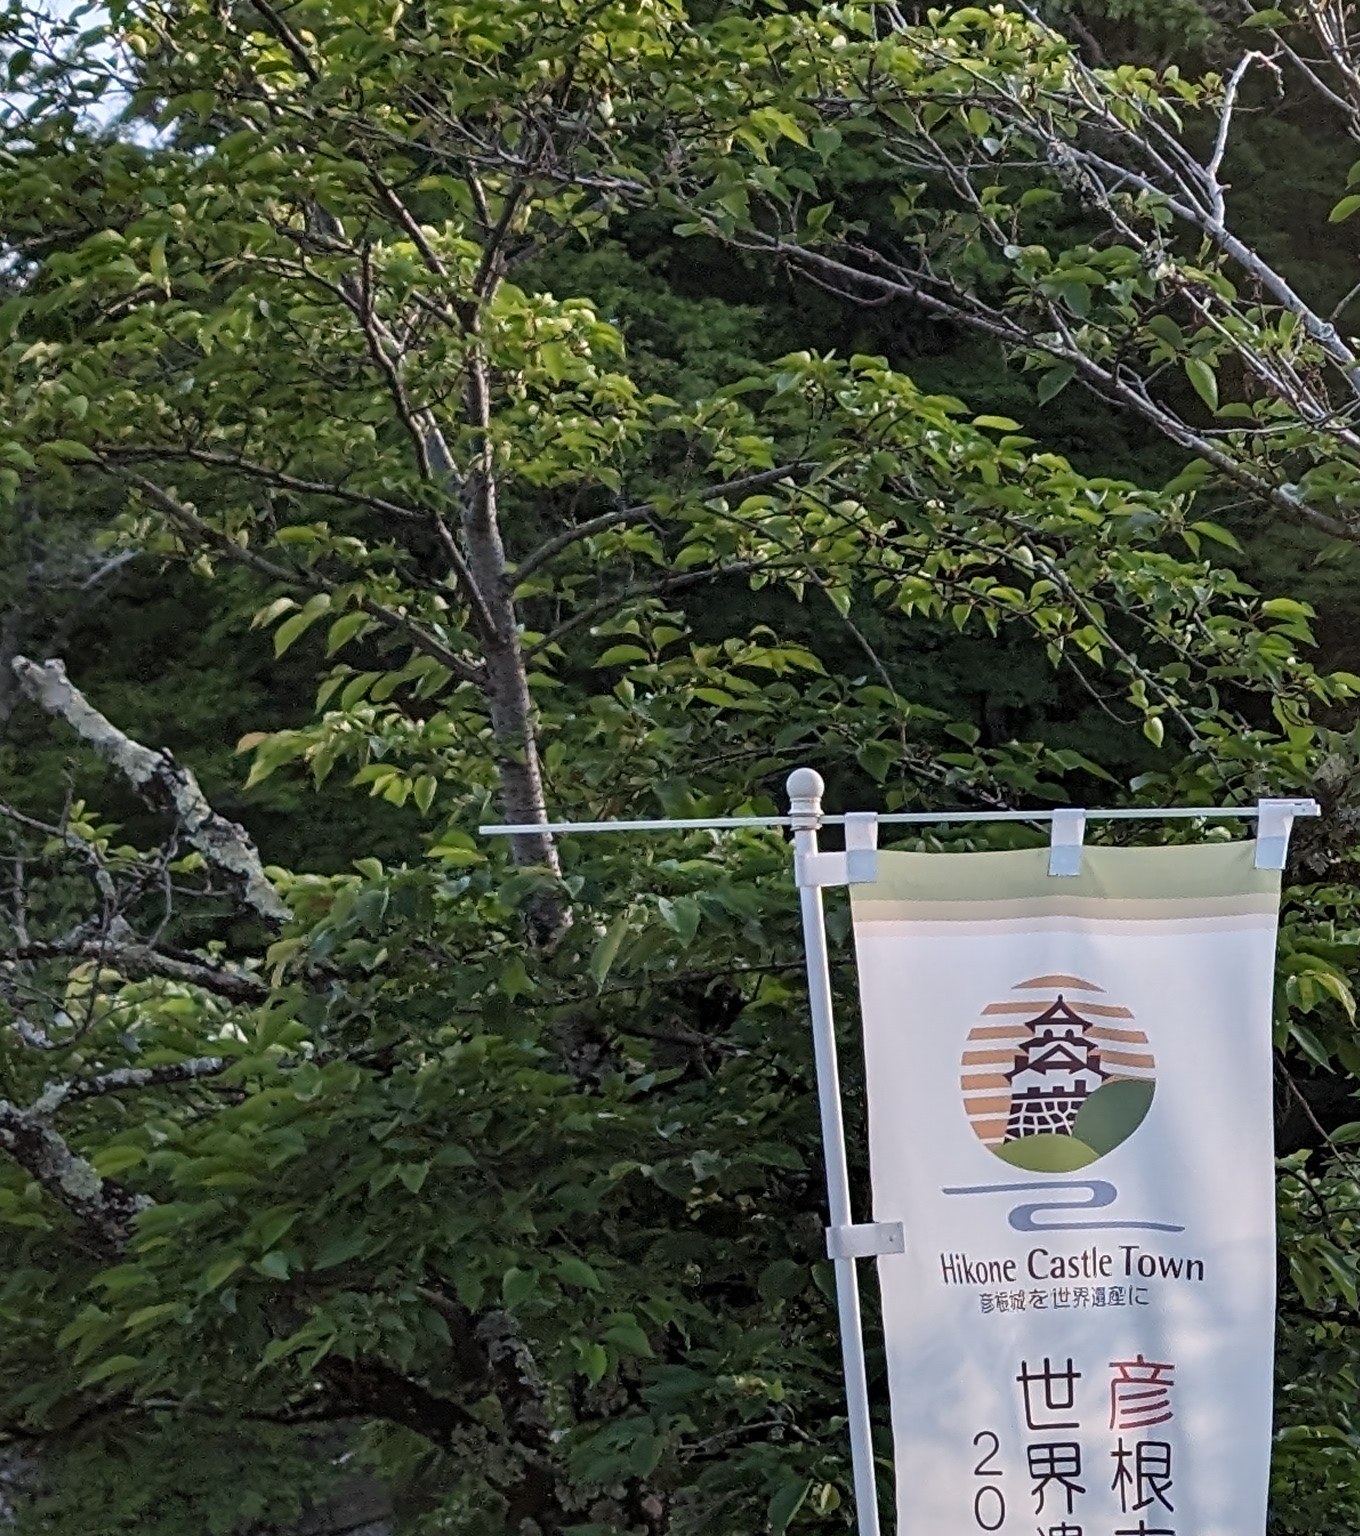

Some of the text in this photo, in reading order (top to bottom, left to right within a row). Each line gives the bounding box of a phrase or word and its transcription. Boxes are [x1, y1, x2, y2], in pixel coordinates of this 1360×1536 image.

[941, 1245, 1204, 1285] Hikone Castle Town
